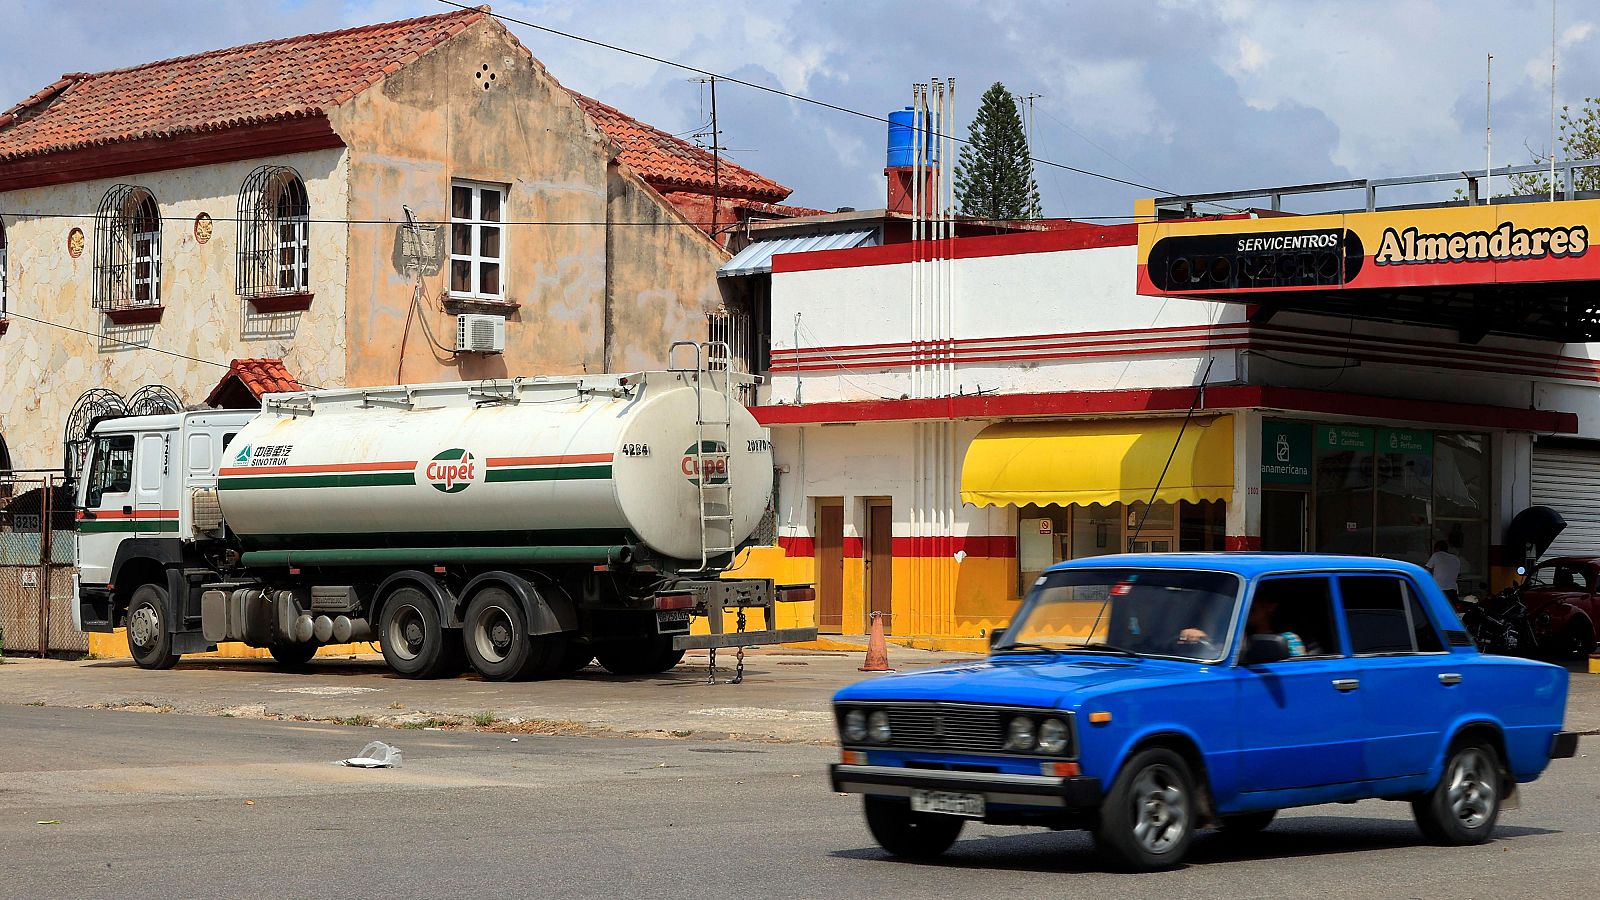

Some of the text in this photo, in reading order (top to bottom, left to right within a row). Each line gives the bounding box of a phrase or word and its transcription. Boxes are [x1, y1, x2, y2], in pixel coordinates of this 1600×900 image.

[1237, 233, 1338, 252] SERVICENTROS
[1375, 224, 1587, 264] Almendares
[1400, 441, 1423, 450] Perfumes
[251, 458, 289, 467] SINOTRUK
[1261, 464, 1308, 476] anamericana
[426, 460, 475, 488] Cupet
